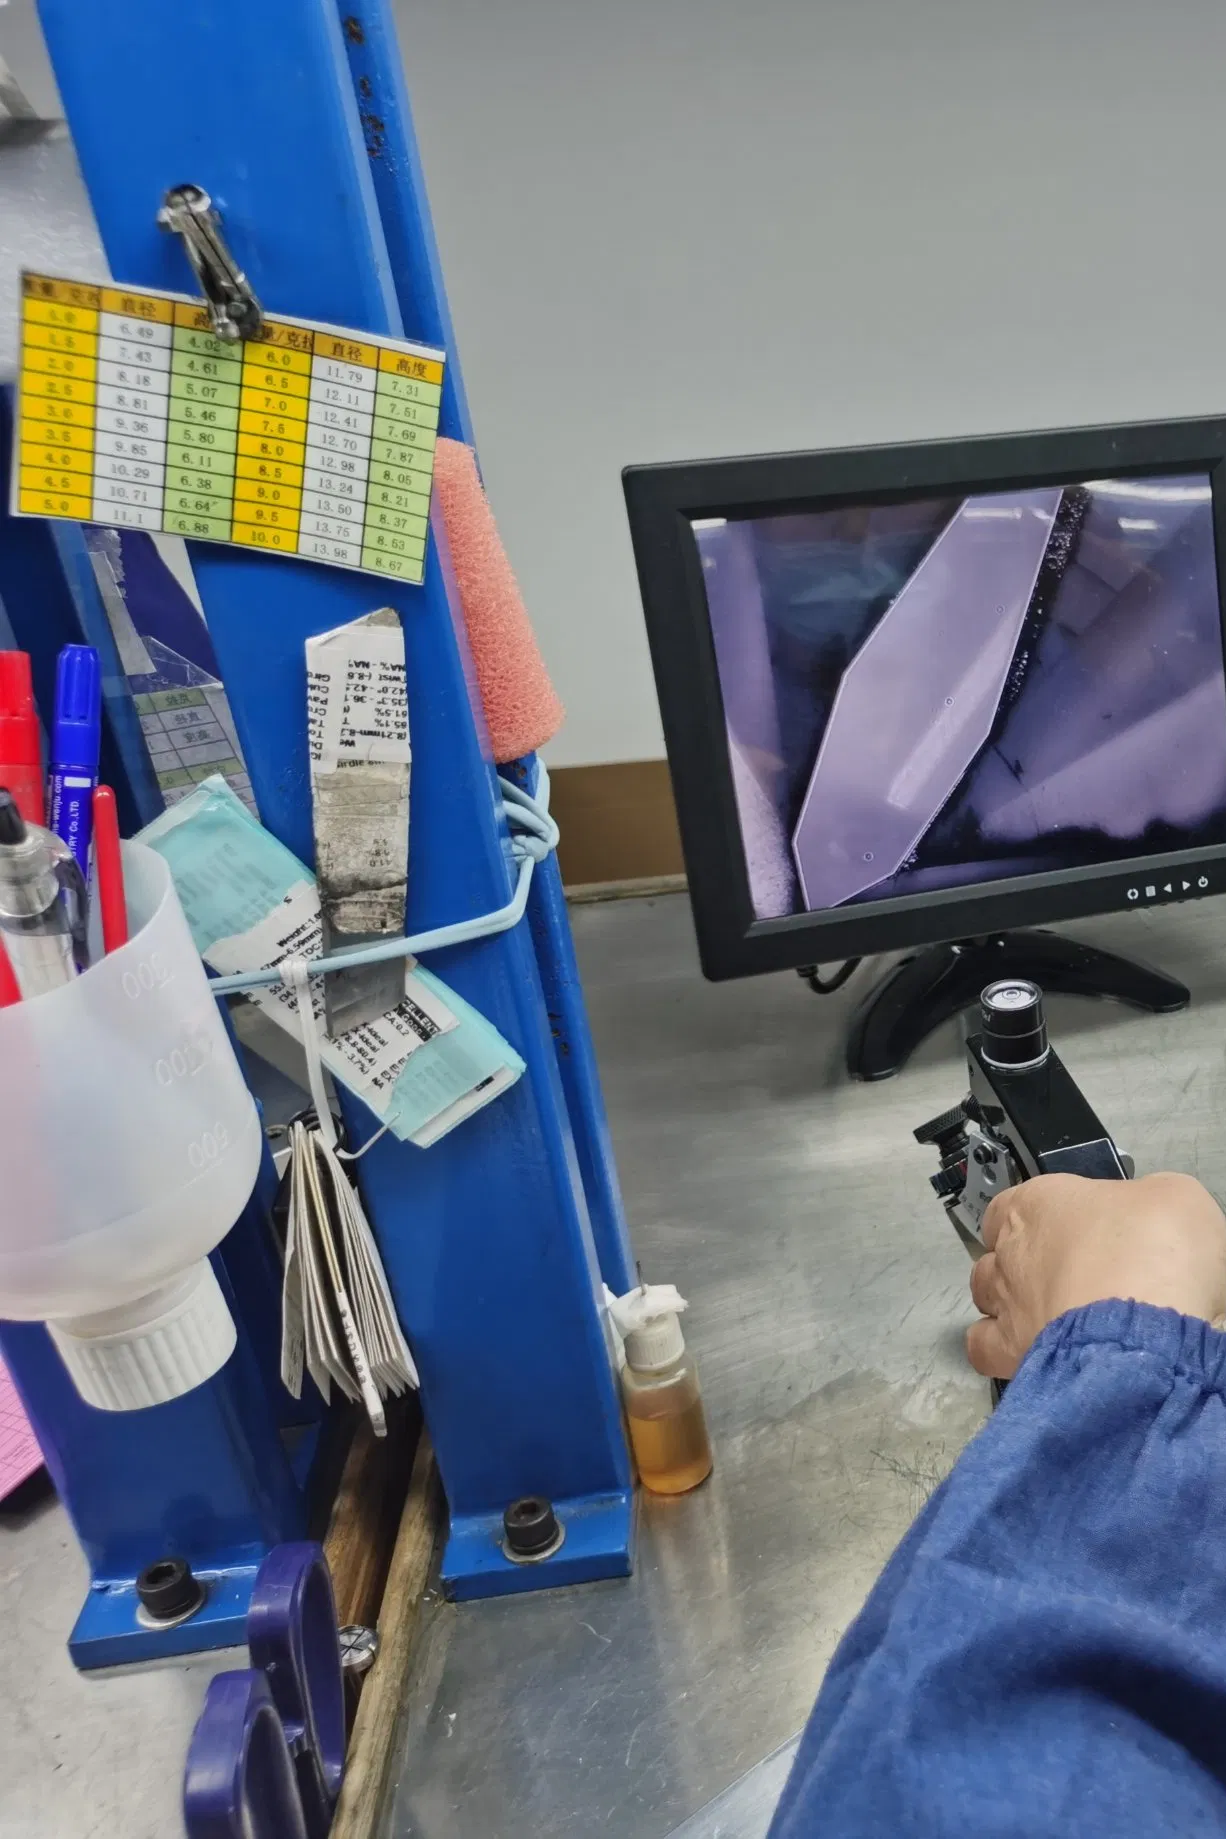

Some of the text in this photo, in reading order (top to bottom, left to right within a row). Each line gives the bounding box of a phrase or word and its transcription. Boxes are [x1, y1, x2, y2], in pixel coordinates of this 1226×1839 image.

[119, 323, 154, 339] 6.49
[188, 335, 221, 351] 4.02
[266, 351, 291, 366] 6.0
[327, 365, 363, 383] 11.79
[391, 381, 419, 397] 7.31
[121, 296, 156, 318] 直径
[331, 341, 362, 363] 直径
[395, 358, 427, 379] 高度
[185, 382, 218, 399] 5.07
[264, 397, 287, 411] 7.0
[323, 410, 358, 428] 12.41
[388, 425, 417, 442] 7.69
[187, 359, 218, 376] 4.61
[264, 374, 289, 389] 6.5
[325, 388, 360, 406] 12.11
[389, 403, 418, 420] 7.51
[114, 416, 149, 433] 9.36
[183, 429, 215, 444] 5.80
[260, 442, 284, 456] 8.0
[320, 455, 355, 473] 12.98
[383, 470, 412, 486] 8.05
[184, 406, 216, 421] 5.46
[262, 420, 285, 435] 7.5
[322, 433, 357, 451] 12.70
[385, 448, 414, 464] 7.87
[111, 463, 150, 479] 10.29
[180, 475, 212, 490] 6.38
[257, 487, 280, 501] 9.0
[316, 499, 352, 516] 13.50
[379, 513, 408, 529] 8.37
[114, 440, 148, 456] 9.85
[181, 451, 212, 467] 6.11
[258, 464, 282, 478] 8.5
[318, 477, 353, 495] 13.24
[381, 492, 409, 508] 8.21
[44, 475, 405, 551] 4.5 10.71 6.64 9.5 13.75 8.53
[44, 498, 403, 572] 5.0 11.1 6.88 10.0 13.98 8.67
